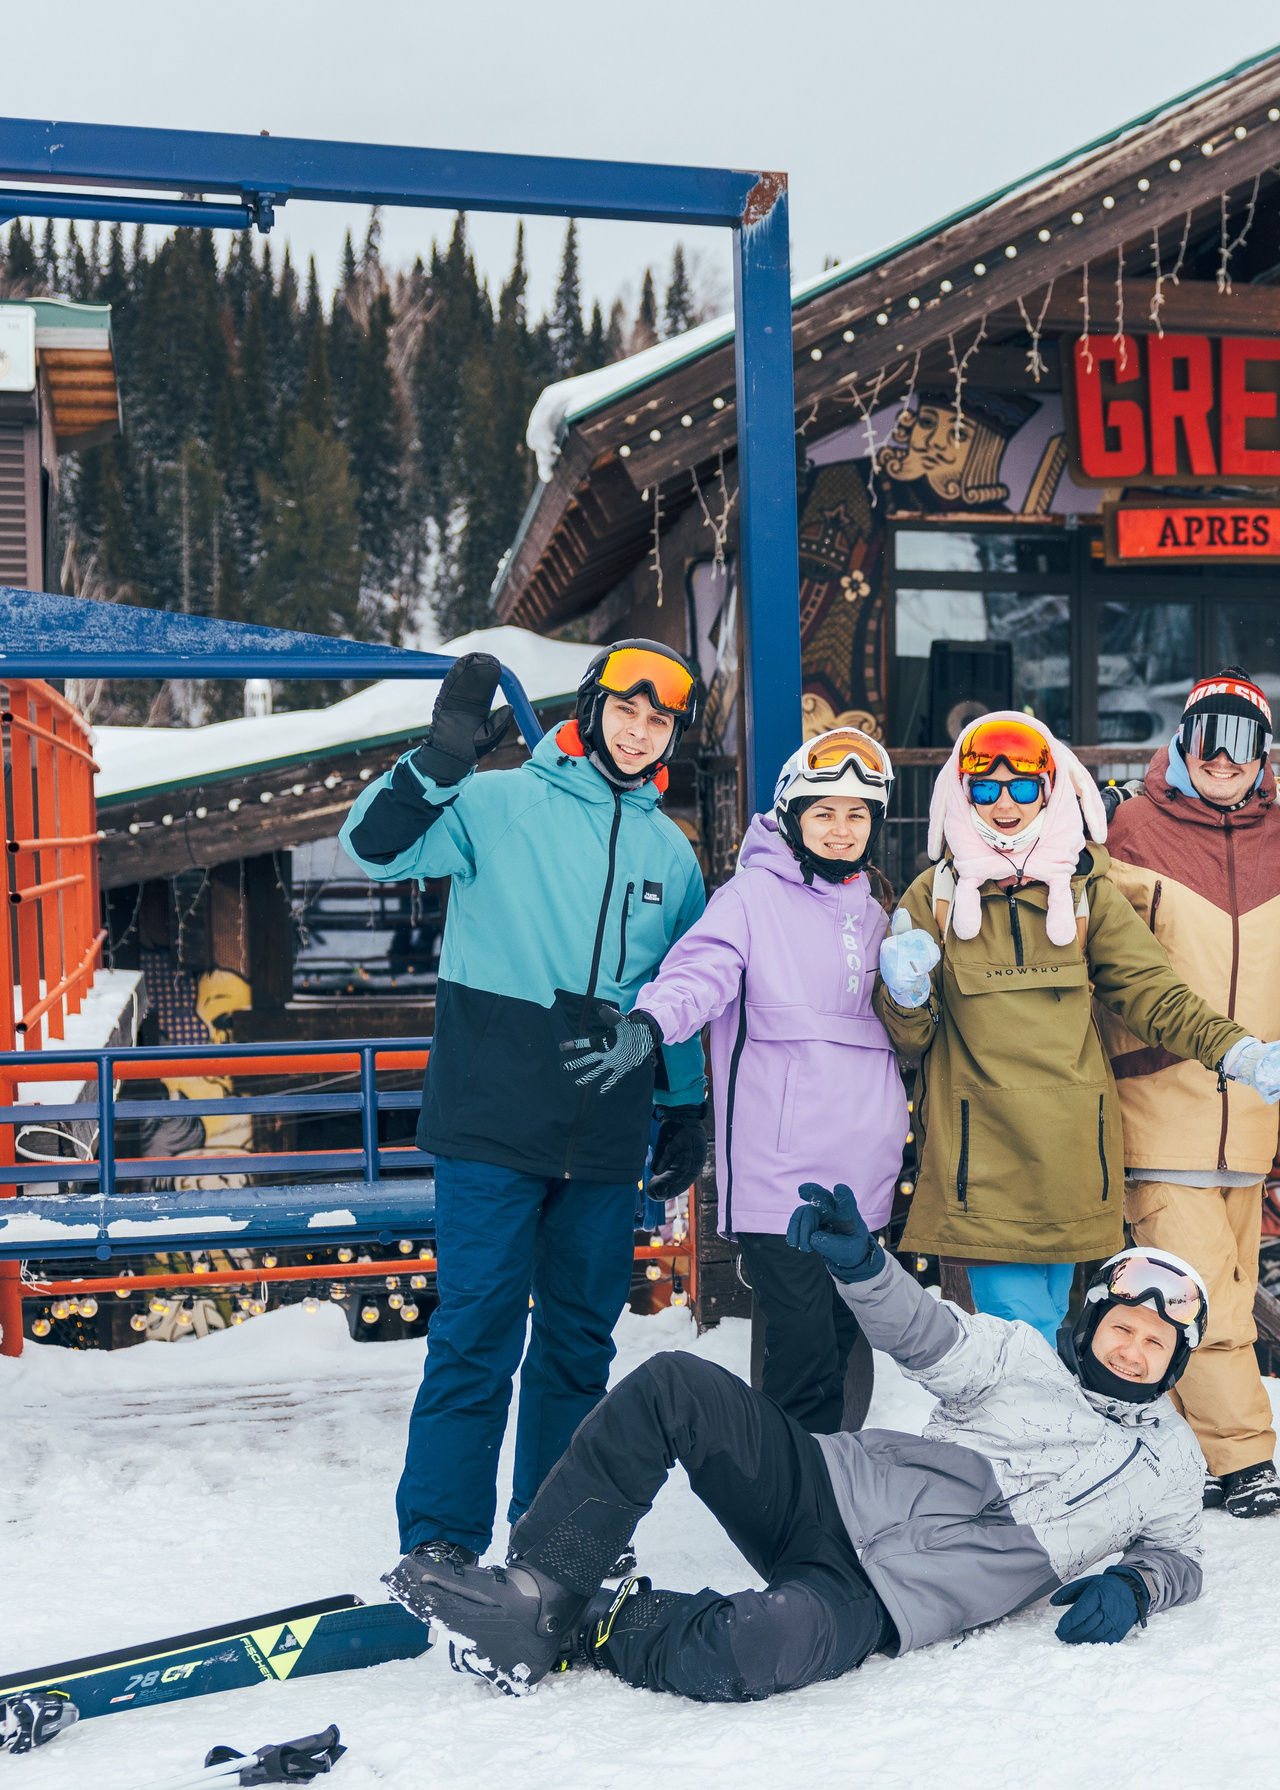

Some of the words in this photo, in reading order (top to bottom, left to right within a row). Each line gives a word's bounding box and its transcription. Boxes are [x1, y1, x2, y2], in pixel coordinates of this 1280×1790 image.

[1157, 514, 1270, 549] APRES
[124, 1670, 160, 1692] 78
[160, 1660, 203, 1684] GT
